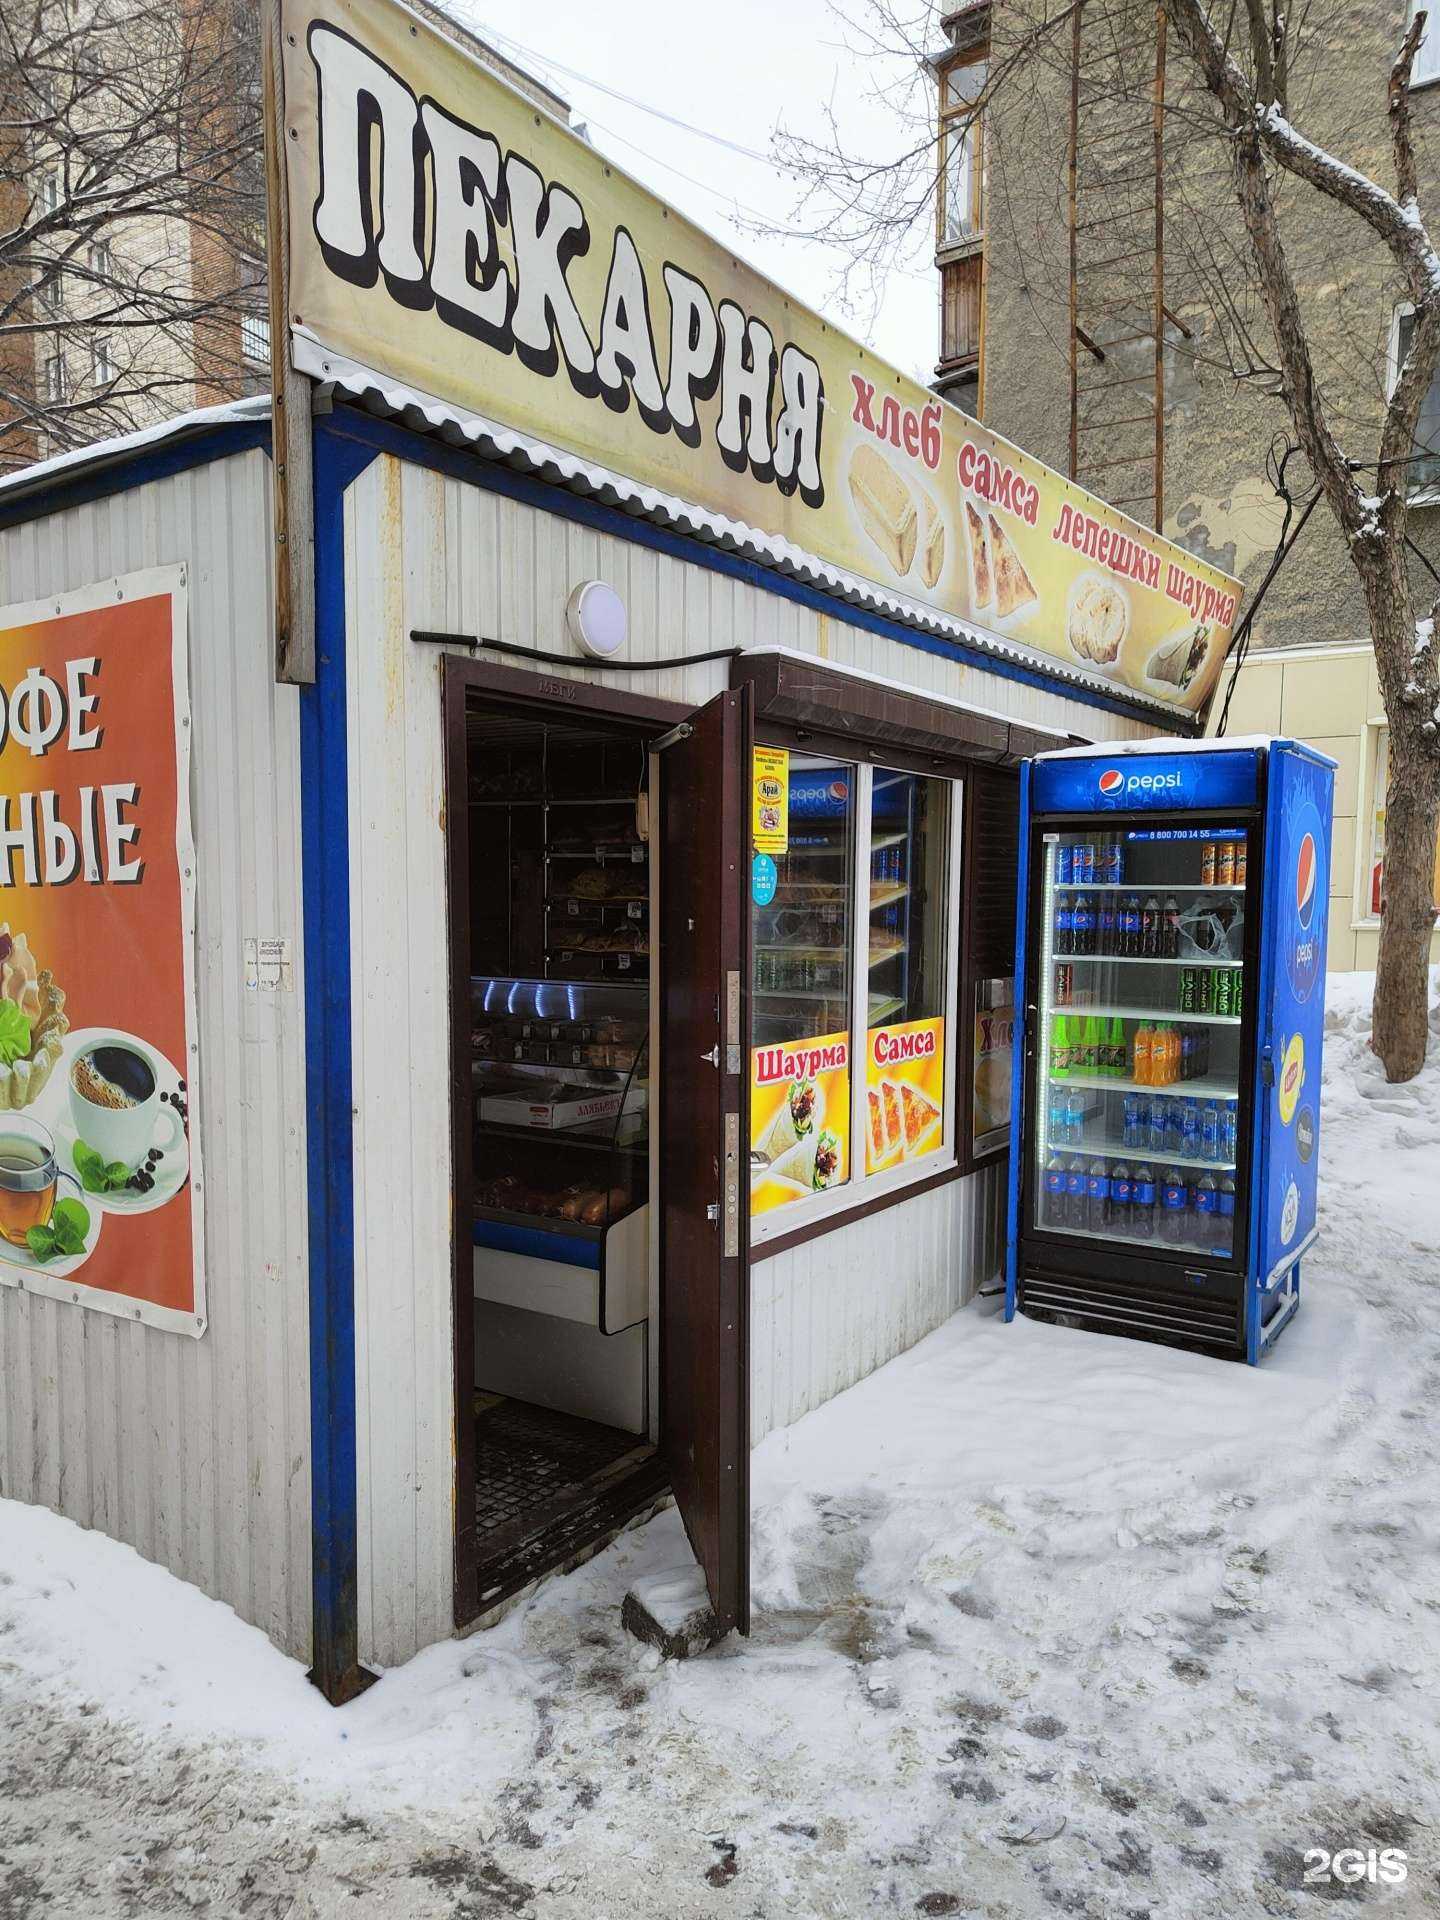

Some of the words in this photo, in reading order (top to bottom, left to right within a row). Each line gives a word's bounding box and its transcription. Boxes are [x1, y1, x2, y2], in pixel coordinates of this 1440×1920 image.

[307, 19, 825, 509] ПЕКАРНЯ
[851, 373, 943, 469] хлеб
[958, 441, 1040, 525] самса
[1053, 503, 1161, 589] лепешки
[1166, 564, 1236, 628] шаурма
[0, 656, 105, 758] ФЕ
[1127, 771, 1182, 793] pepsi
[1149, 831, 1155, 840] 8
[1156, 831, 1172, 839] 800
[1173, 830, 1187, 839] 700
[1189, 829, 1198, 839] 14
[1296, 938, 1313, 969] pepsi
[756, 1045, 846, 1082] Шаурма
[874, 1031, 935, 1064] Самса
